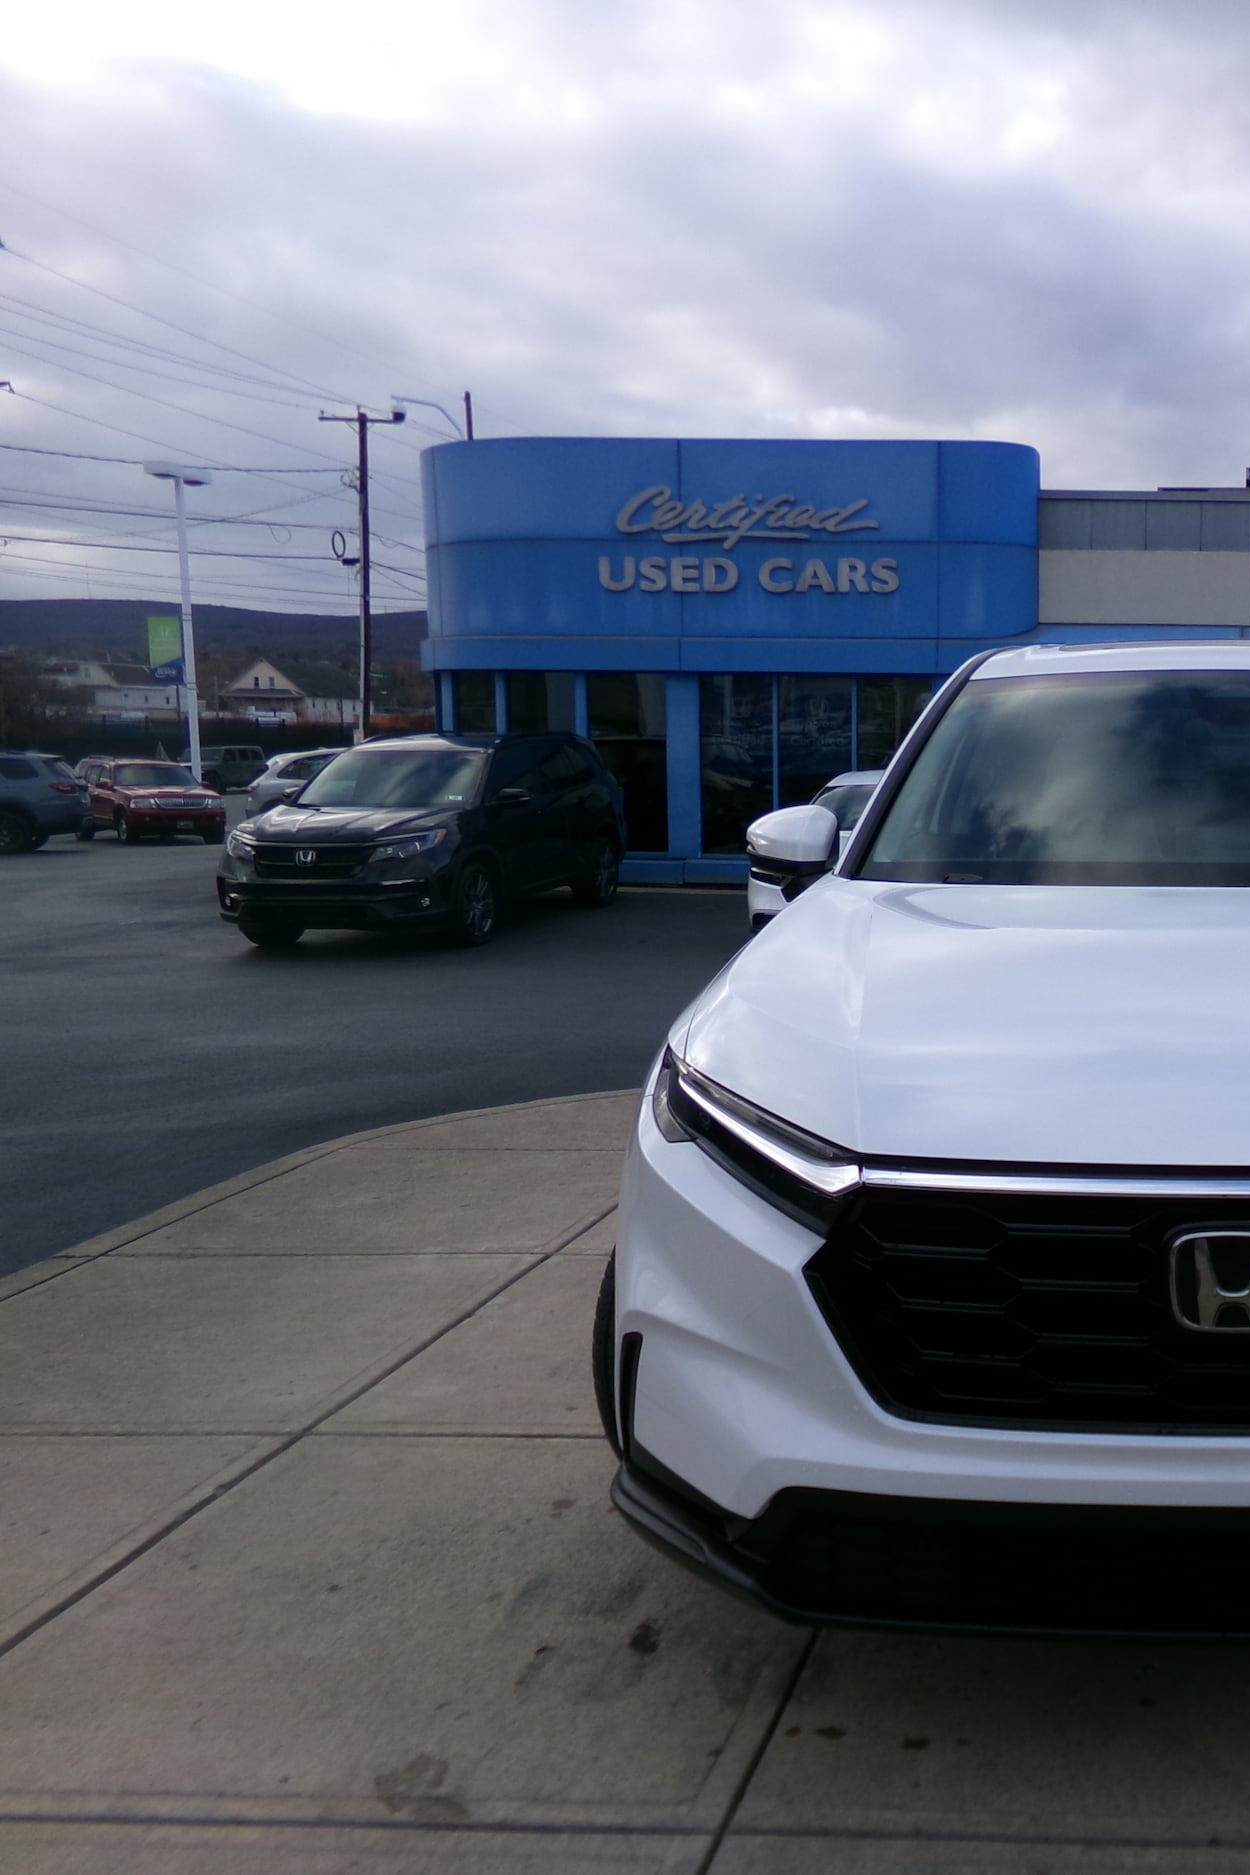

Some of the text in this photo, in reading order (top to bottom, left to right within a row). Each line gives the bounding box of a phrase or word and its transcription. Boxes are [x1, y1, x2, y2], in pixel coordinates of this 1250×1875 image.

[615, 484, 880, 550] Certified
[598, 556, 901, 594] USED CARS
